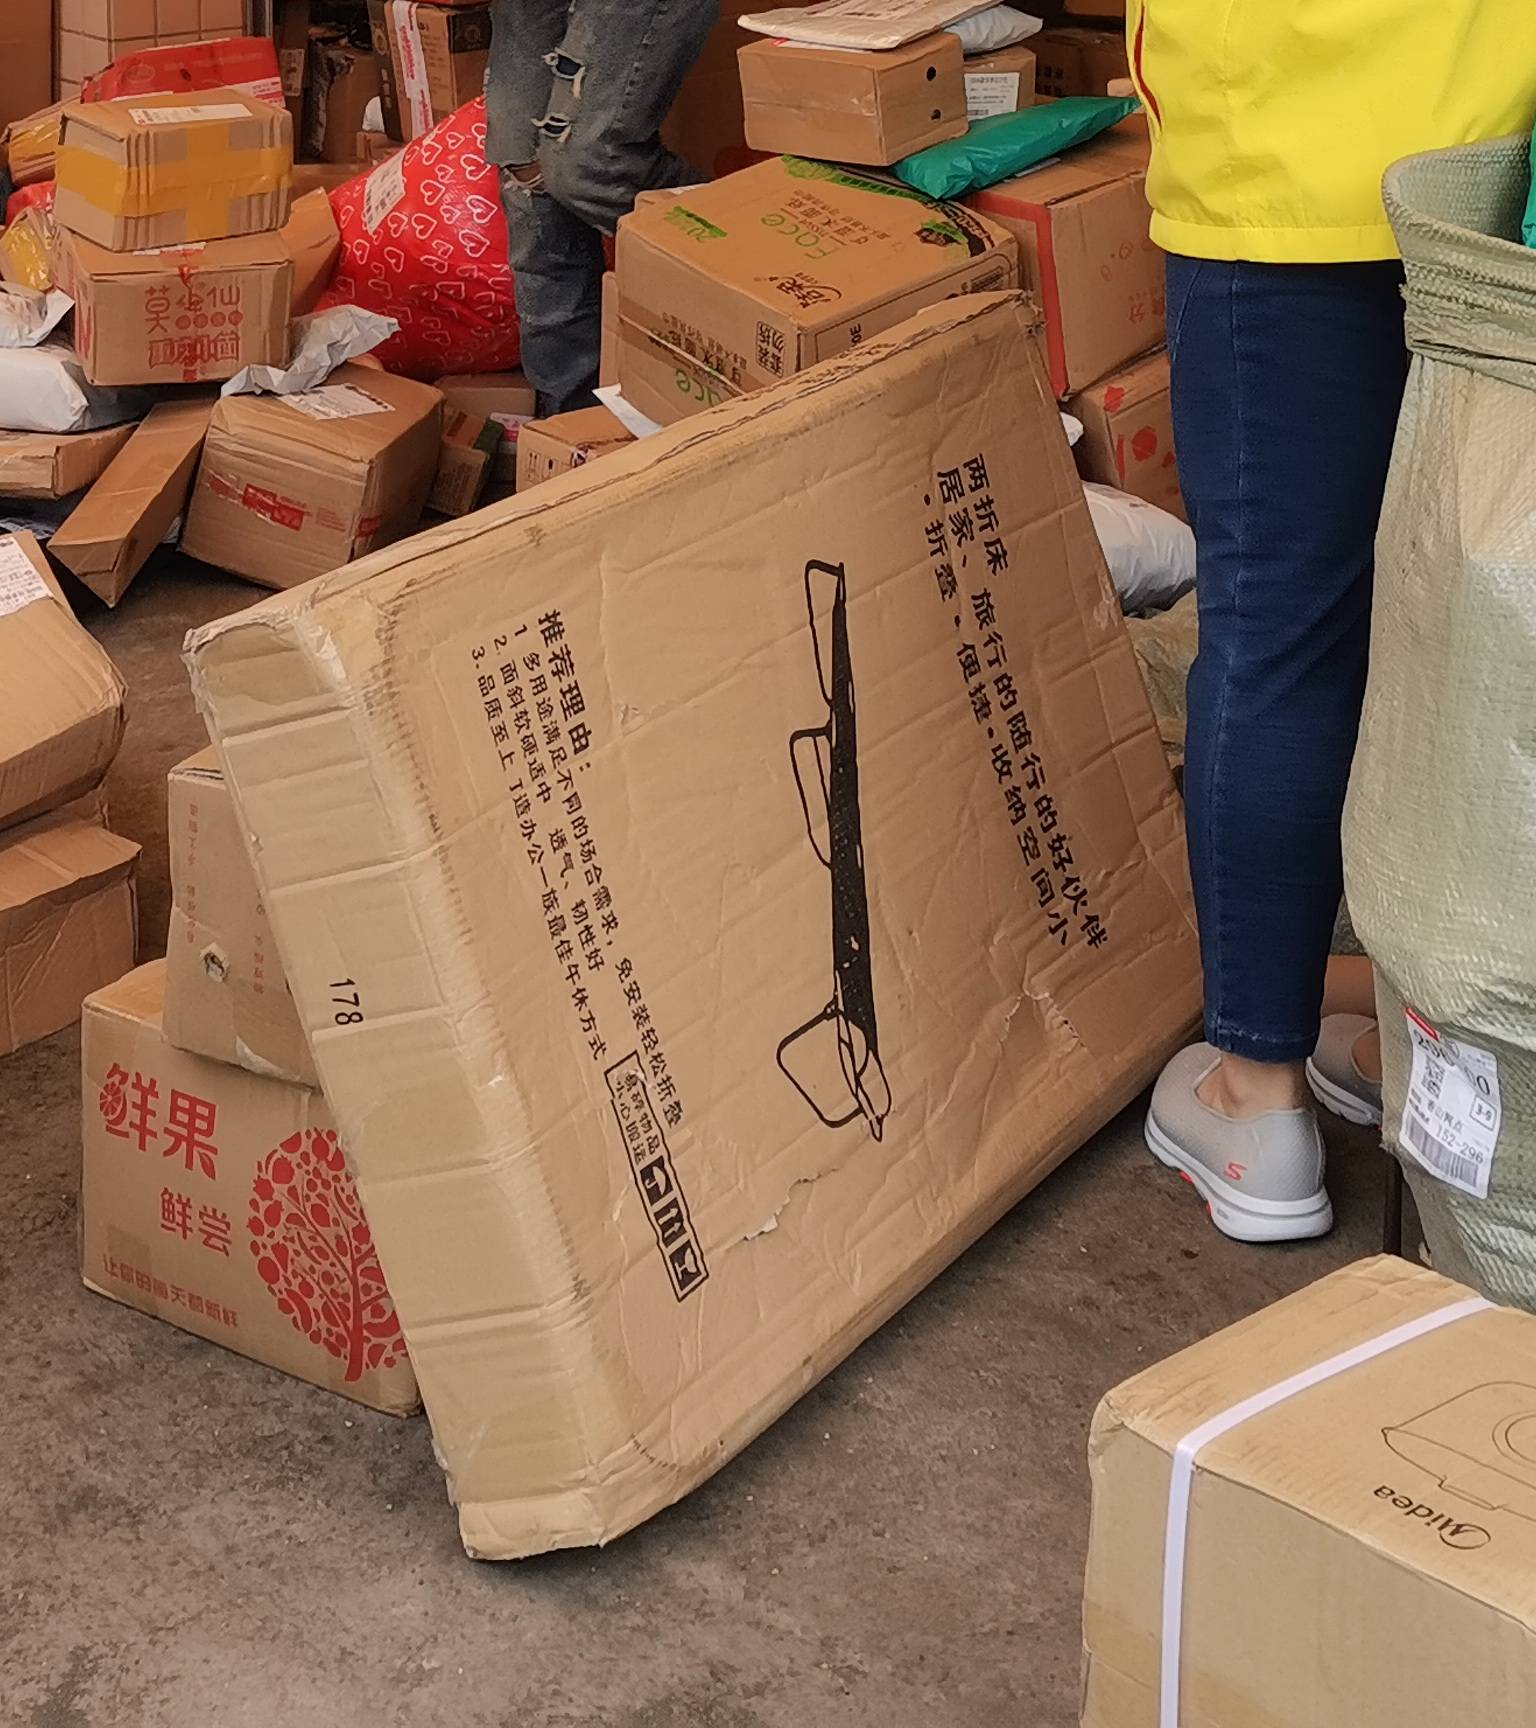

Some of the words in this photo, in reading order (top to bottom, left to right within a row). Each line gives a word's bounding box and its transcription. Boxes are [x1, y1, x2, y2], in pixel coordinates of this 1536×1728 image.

[963, 453, 1009, 576] 两折床
[328, 976, 365, 1028] 178
[99, 1061, 220, 1180] 鲜果
[1435, 1125, 1484, 1165] 152-296
[159, 1186, 232, 1258] 鲜尝
[1373, 1484, 1492, 1551] Midea
